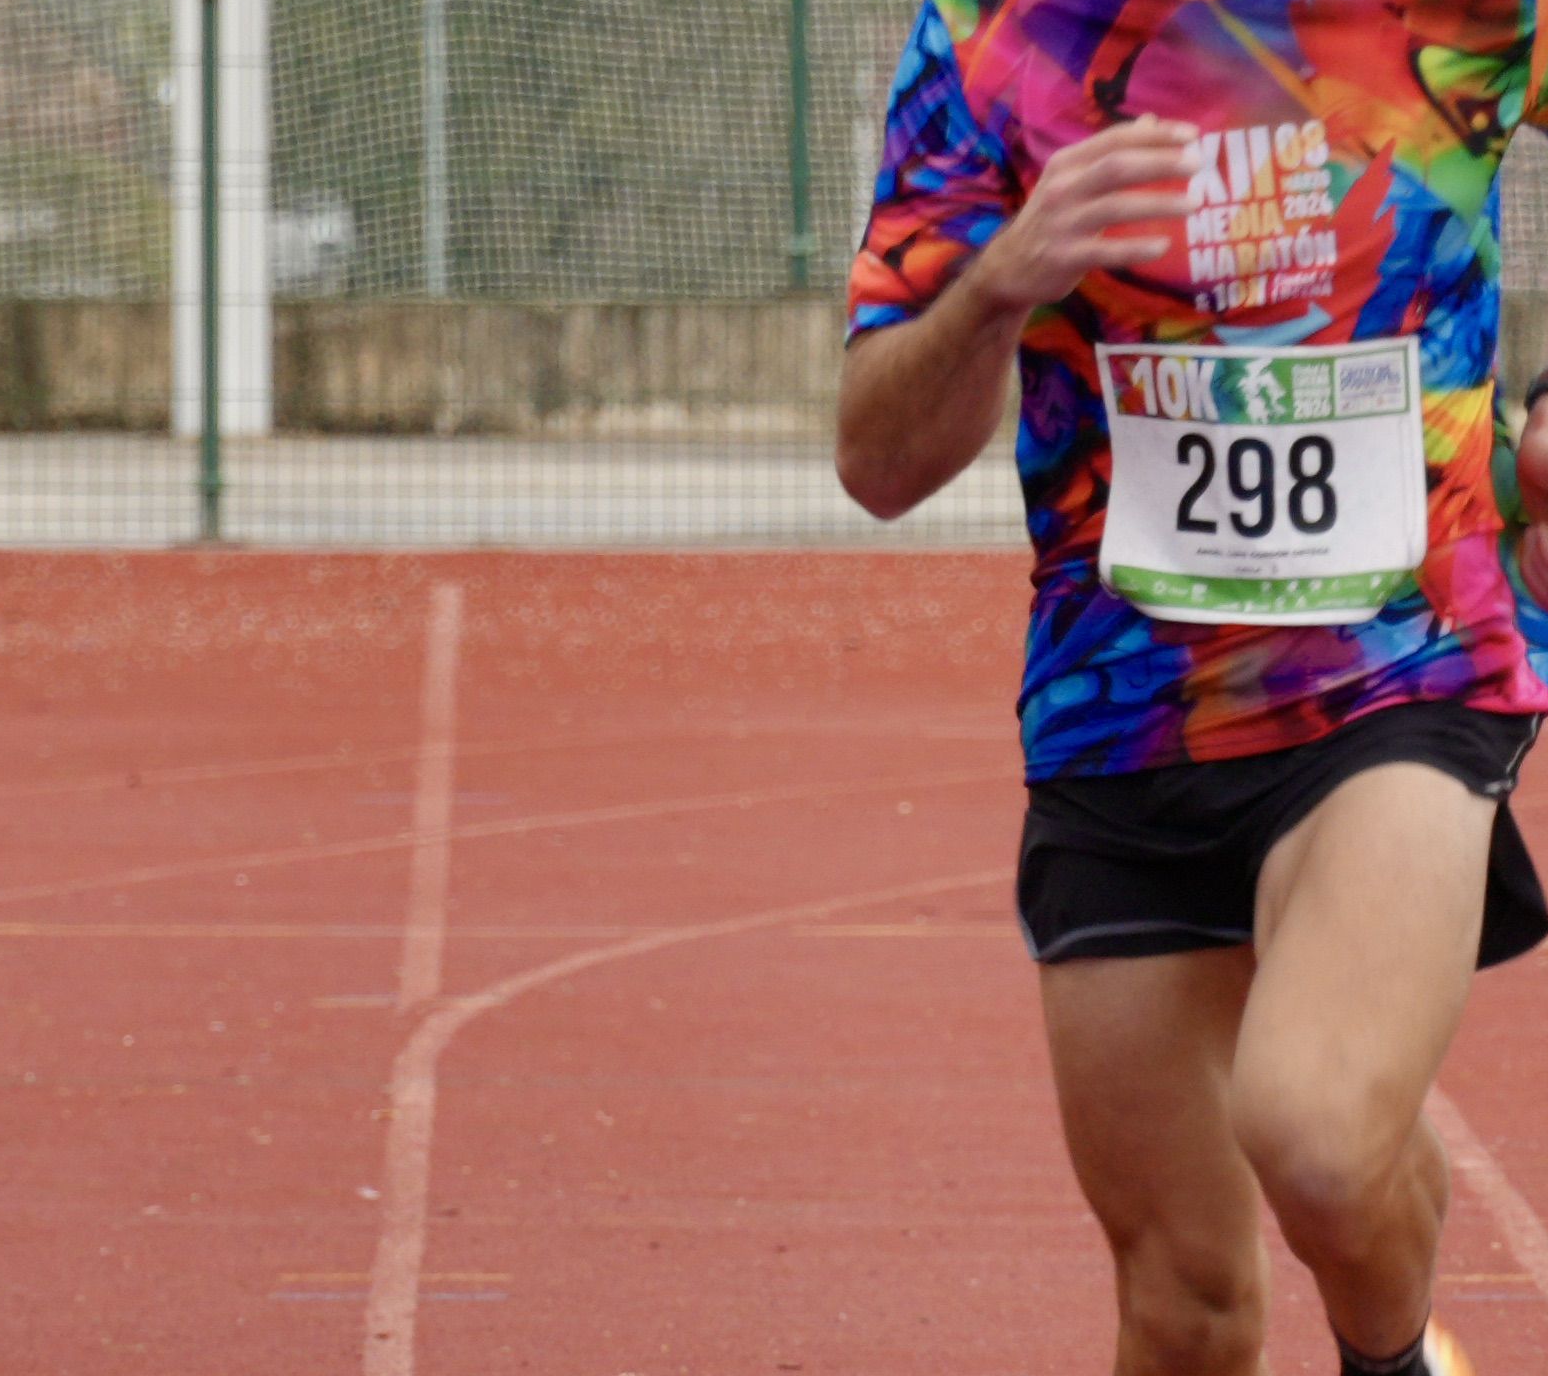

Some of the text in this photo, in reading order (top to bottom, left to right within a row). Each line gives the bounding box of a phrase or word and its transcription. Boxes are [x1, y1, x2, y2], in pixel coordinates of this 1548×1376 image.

[1187, 126, 1276, 208] XII
[1275, 119, 1330, 170] 08
[1187, 200, 1285, 245] MEDIA
[1283, 192, 1334, 220] 2026
[1189, 224, 1338, 284] MARATÓN
[1212, 274, 1269, 313] 10K
[1132, 357, 1219, 420] 10K
[1175, 432, 1339, 539] 298
